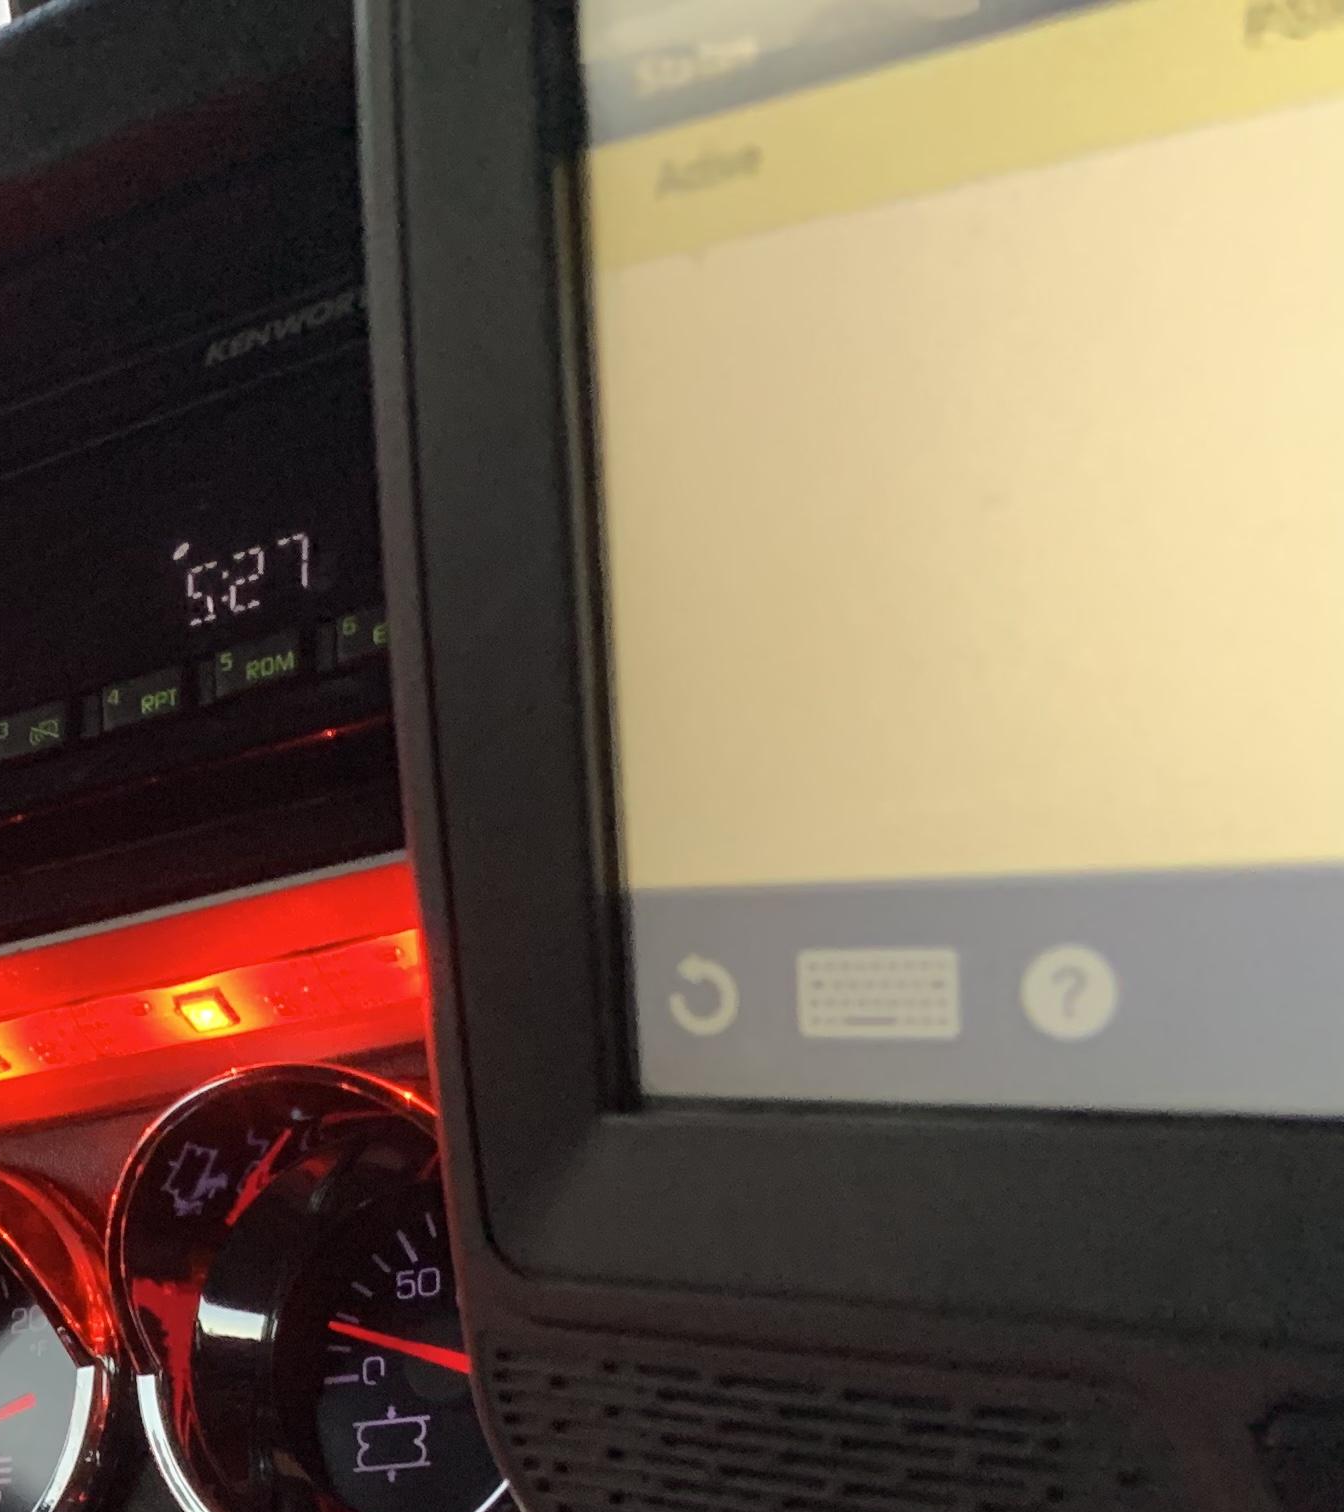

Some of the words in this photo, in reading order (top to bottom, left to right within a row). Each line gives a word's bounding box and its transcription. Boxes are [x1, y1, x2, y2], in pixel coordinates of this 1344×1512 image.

[188, 532, 309, 627] 5:27
[219, 652, 233, 672] 5
[245, 650, 295, 681] ROM
[141, 688, 177, 714] RPT
[396, 1267, 440, 1300] 50
